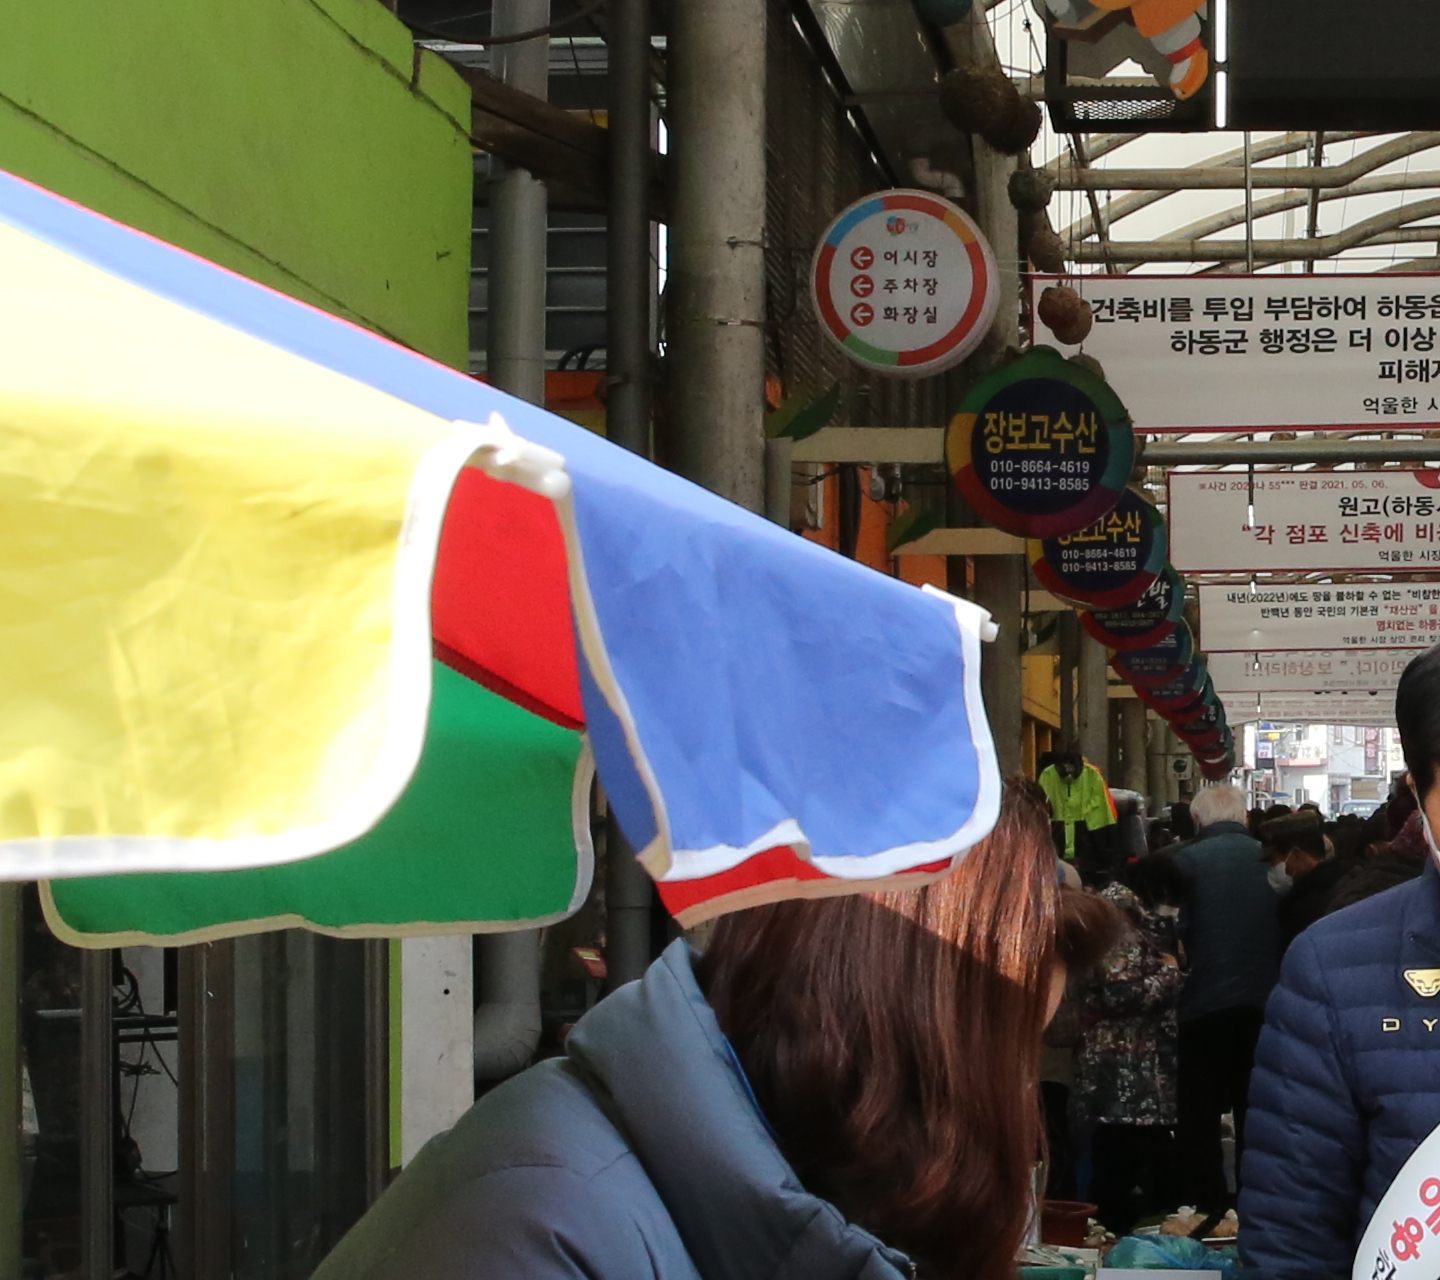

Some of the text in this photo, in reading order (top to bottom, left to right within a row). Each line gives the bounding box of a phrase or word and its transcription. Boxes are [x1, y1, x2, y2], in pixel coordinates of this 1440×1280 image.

[883, 250, 937, 268] 어시장
[883, 279, 937, 295] 주차장
[883, 307, 937, 324] 화장실
[1091, 297, 1193, 323] 건축비를
[1203, 296, 1253, 321] 투입
[1264, 296, 1367, 321] 부담하여
[1171, 329, 1248, 355] 하동군
[1259, 328, 1337, 353] 행정은
[1350, 329, 1372, 351] 더
[1384, 328, 1436, 351] 이상
[1363, 396, 1417, 415] 억울한
[984, 411, 1098, 454] 장보고수산
[991, 460, 1090, 473] 010-8664-4619
[991, 477, 1089, 490] 010-9413-8585
[1286, 523, 1328, 543] 점포
[1340, 523, 1403, 543] 신축에
